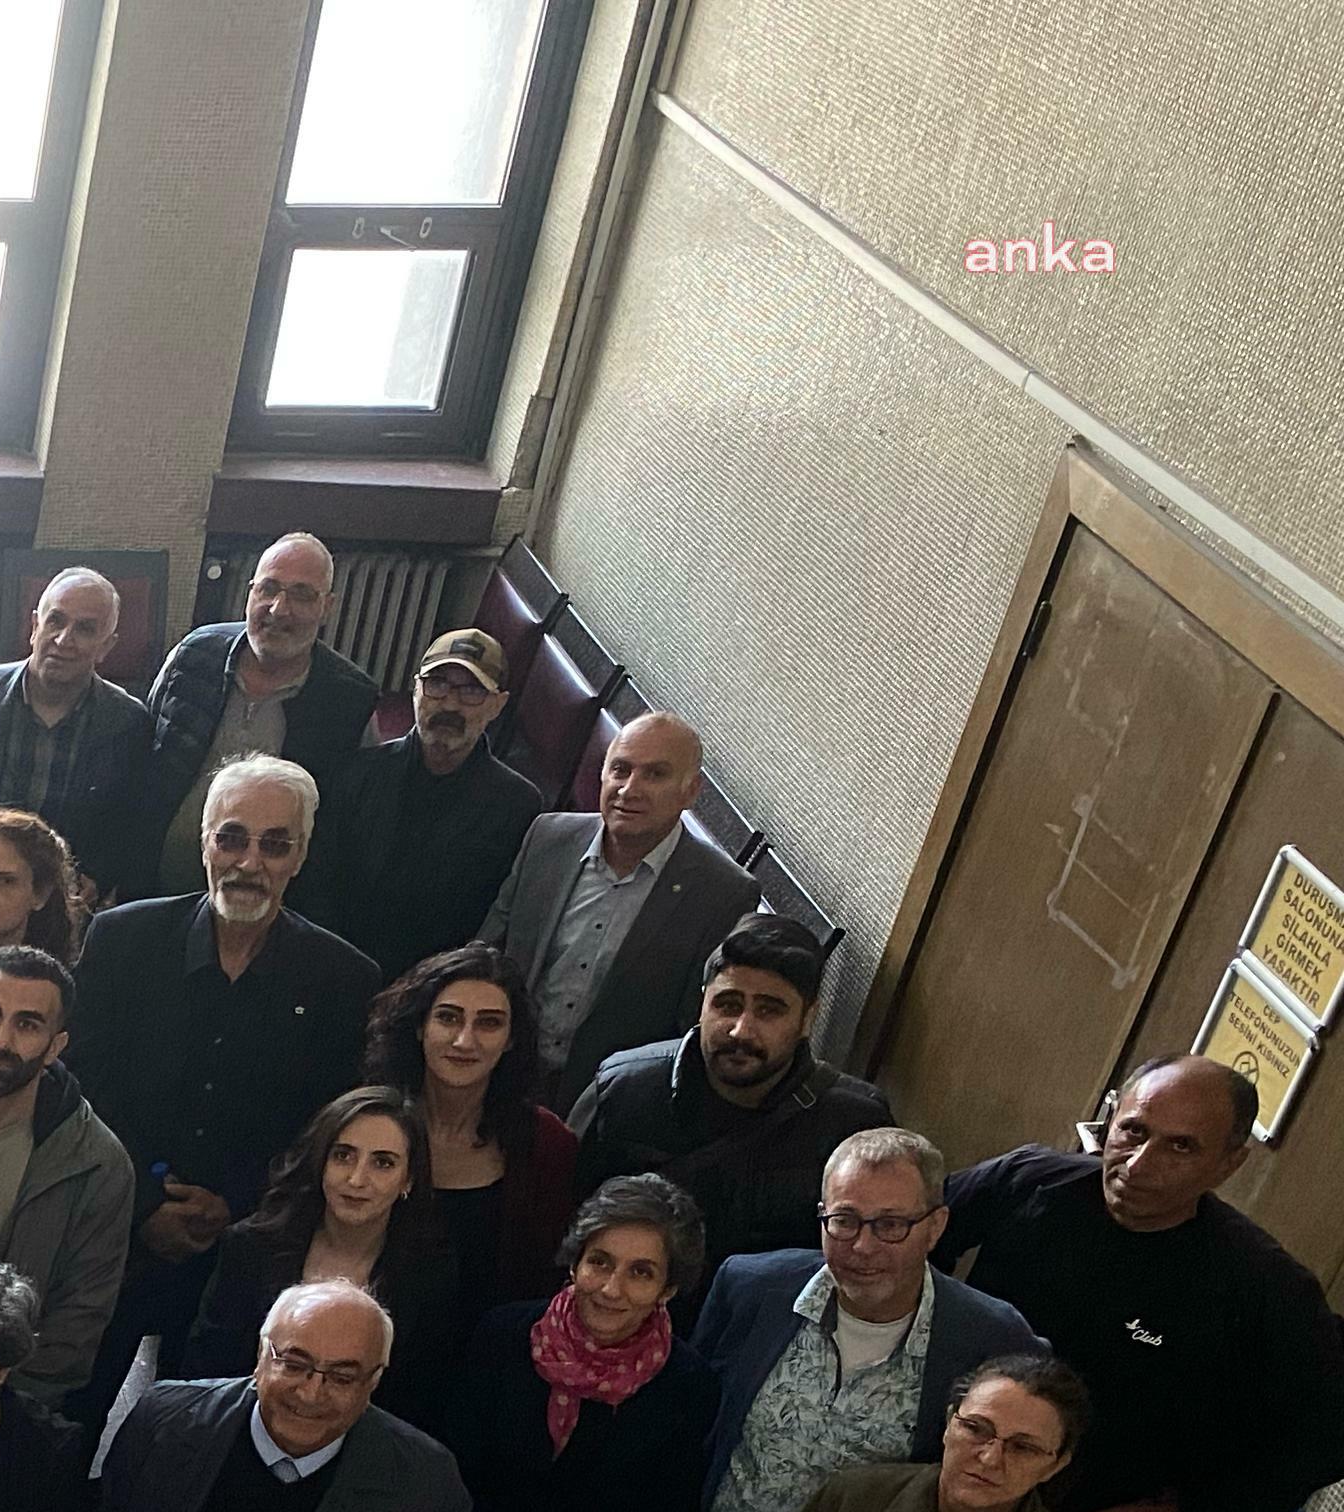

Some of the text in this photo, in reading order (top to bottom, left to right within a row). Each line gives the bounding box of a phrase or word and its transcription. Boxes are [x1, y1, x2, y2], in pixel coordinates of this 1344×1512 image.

[1294, 873, 1344, 929] DURUŞM
[1263, 944, 1320, 1009] YASAKTIR
[1132, 1328, 1163, 1346] Club
